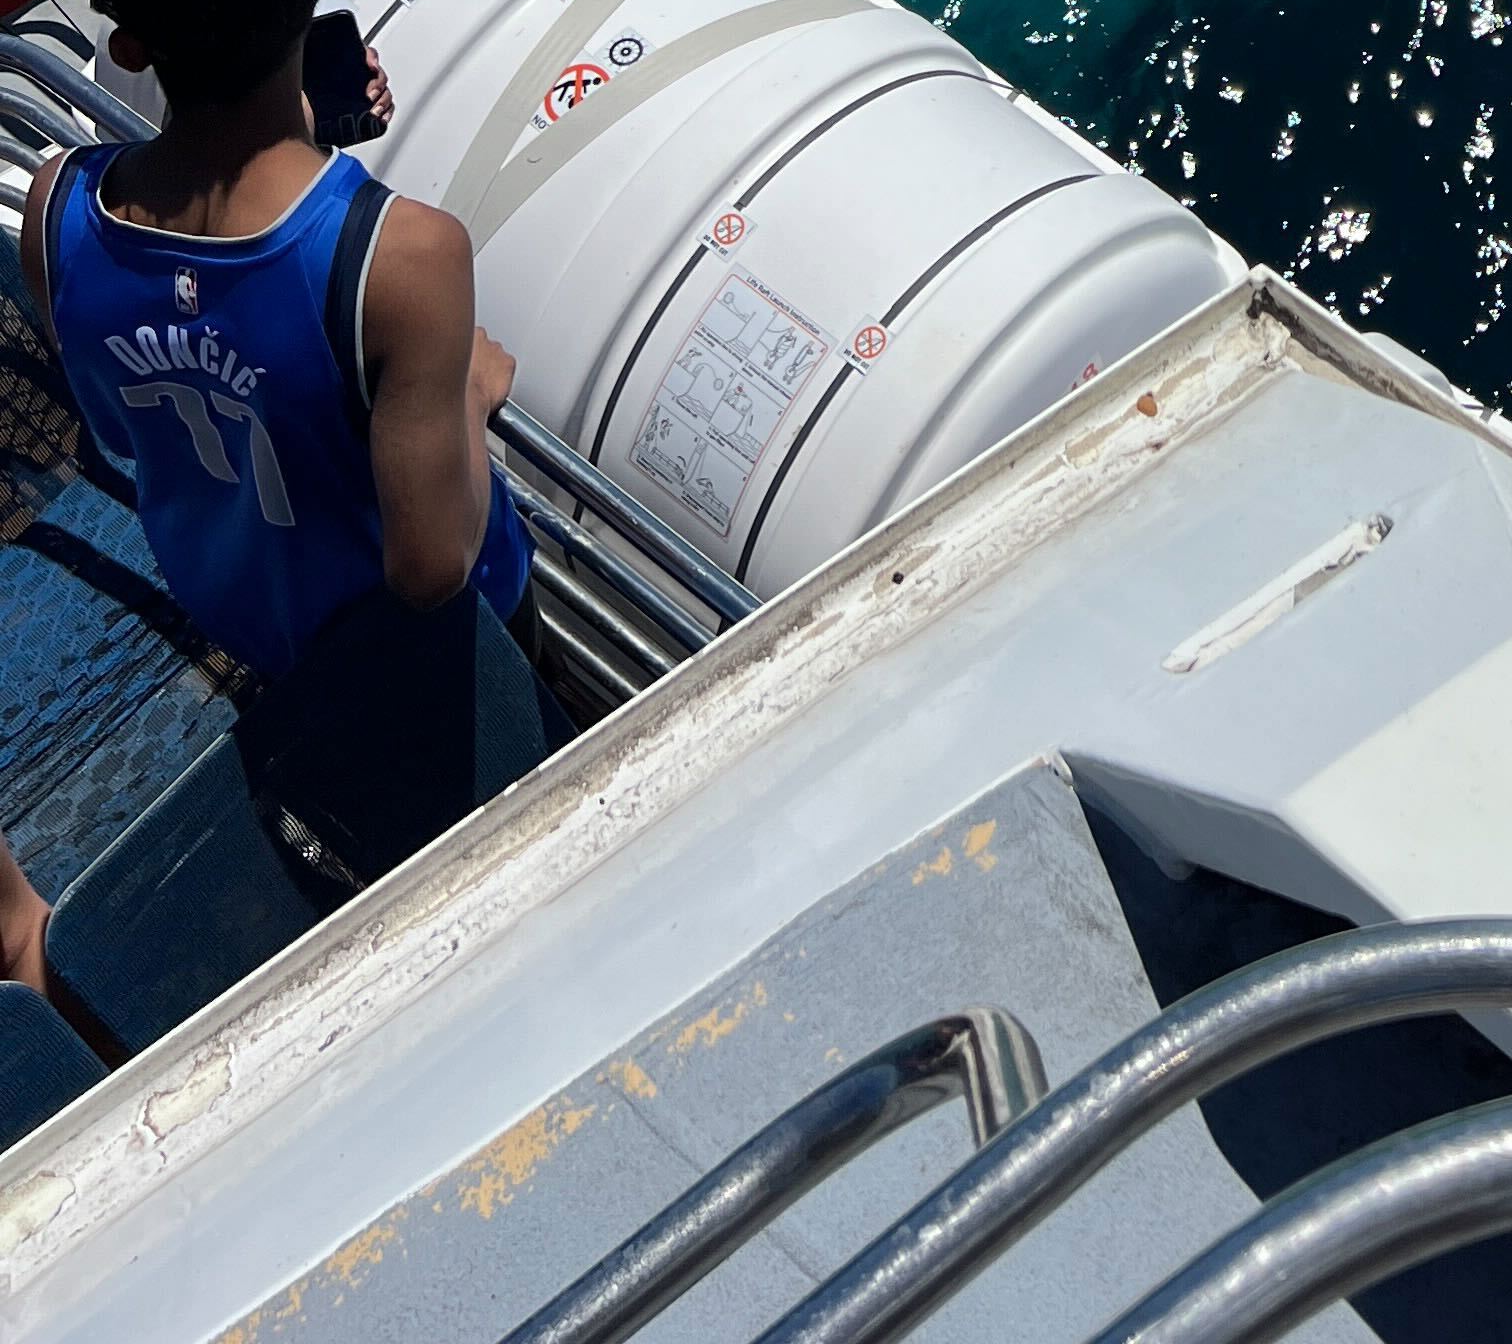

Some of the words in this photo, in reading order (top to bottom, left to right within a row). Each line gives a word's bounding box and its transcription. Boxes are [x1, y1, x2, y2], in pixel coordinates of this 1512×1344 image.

[531, 114, 550, 129] NO
[746, 275, 758, 288] Life
[758, 284, 771, 297] Raft
[769, 293, 790, 312] Launch
[790, 309, 821, 336] Instruction
[103, 324, 267, 397] DONČIĆ
[119, 381, 296, 526] 77
